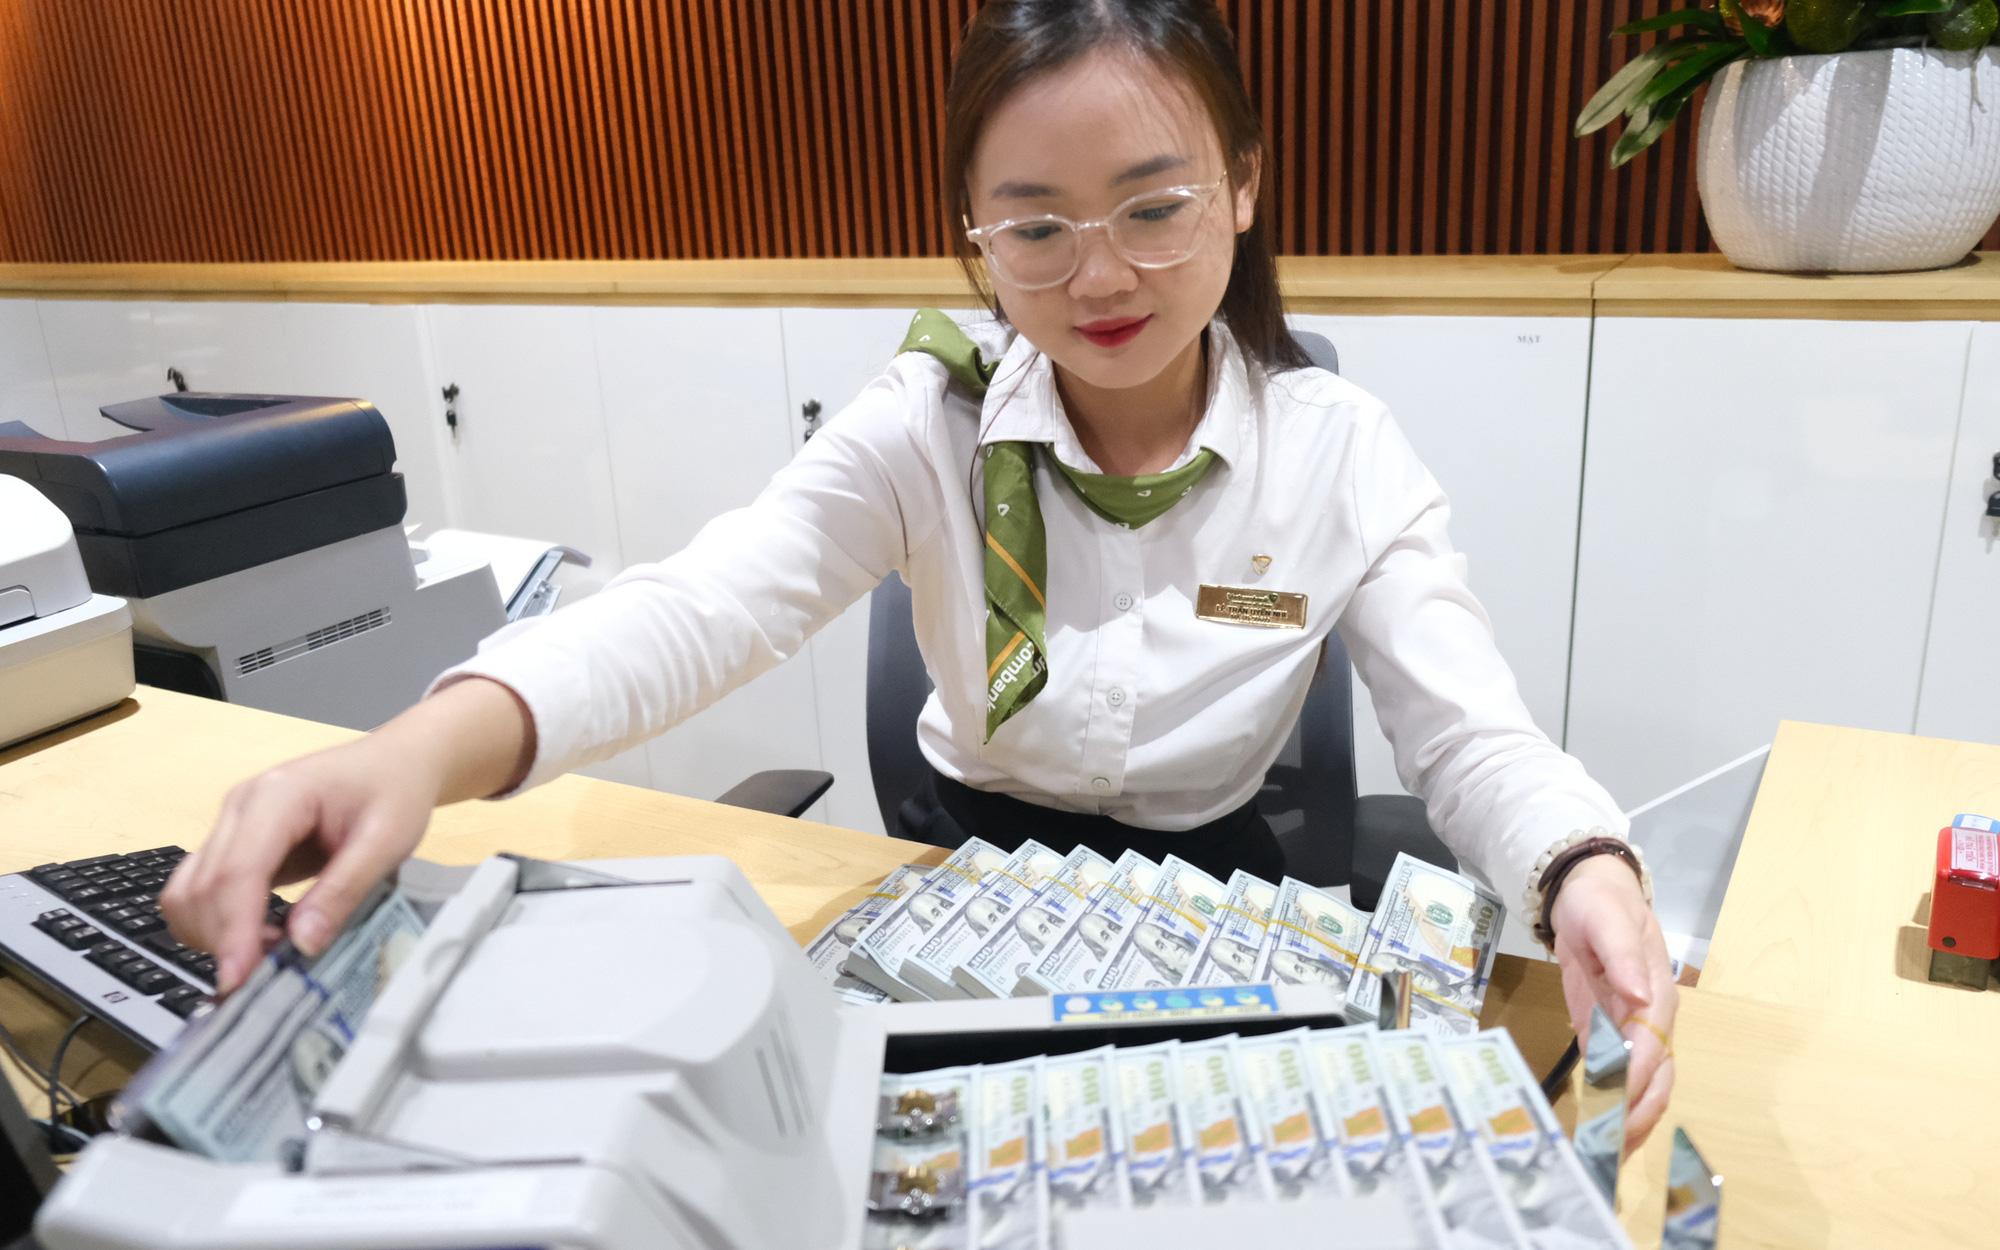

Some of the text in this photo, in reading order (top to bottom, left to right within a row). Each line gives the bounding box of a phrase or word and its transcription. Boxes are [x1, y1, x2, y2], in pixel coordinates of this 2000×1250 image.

[962, 844, 980, 859] 100
[1018, 846, 1037, 862] 100
[1068, 853, 1088, 869] 100
[1120, 858, 1137, 875] 100
[1165, 864, 1180, 881] 100
[1234, 878, 1249, 895] 100
[1396, 867, 1412, 891] 100
[1286, 886, 1299, 903] 100
[1475, 906, 1493, 937] 100
[867, 926, 887, 947] 100
[918, 934, 943, 959] 100
[969, 944, 993, 968] 100
[1038, 951, 1061, 975] 100
[1099, 965, 1120, 990] 100
[1278, 1048, 1301, 1089] 100
[1347, 1043, 1371, 1084] 100
[1408, 1045, 1434, 1084] 100
[1479, 1047, 1510, 1085] 100
[1082, 1067, 1099, 1105] 100
[1148, 1061, 1166, 1100] 100
[1207, 1056, 1229, 1096] 100
[1011, 1076, 1028, 1115] 100
